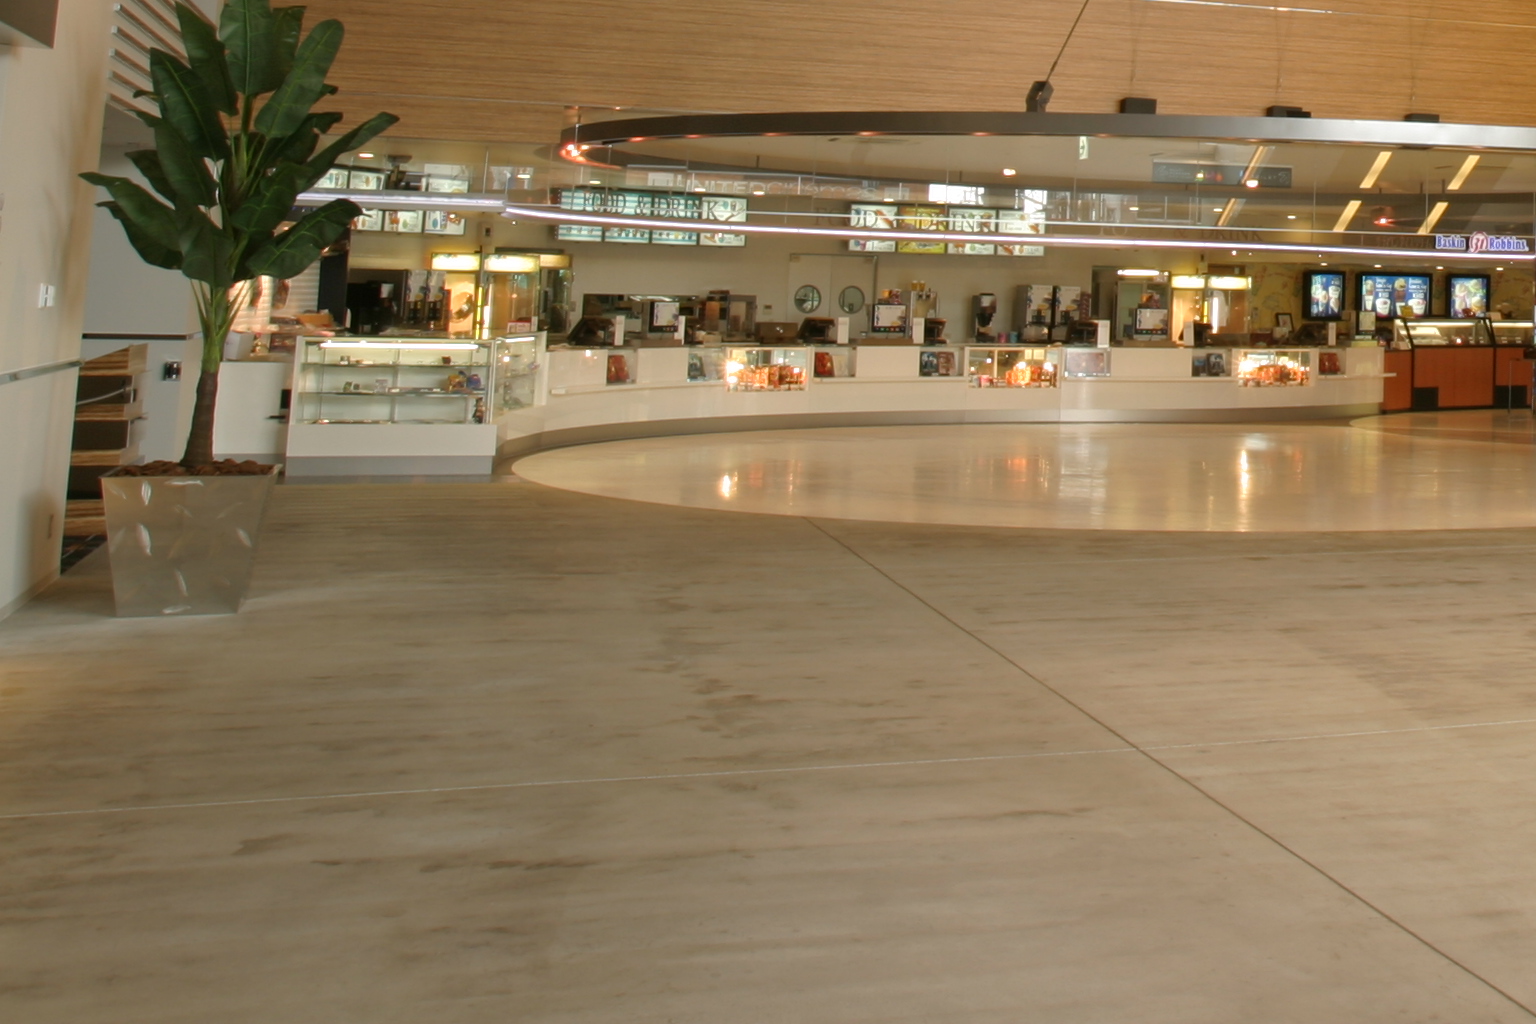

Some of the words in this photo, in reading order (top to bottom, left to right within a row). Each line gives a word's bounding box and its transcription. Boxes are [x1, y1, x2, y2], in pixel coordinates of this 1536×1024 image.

[655, 196, 720, 222] DRINK
[1436, 235, 1466, 250] Baskin
[1489, 236, 1527, 251] Robbins
